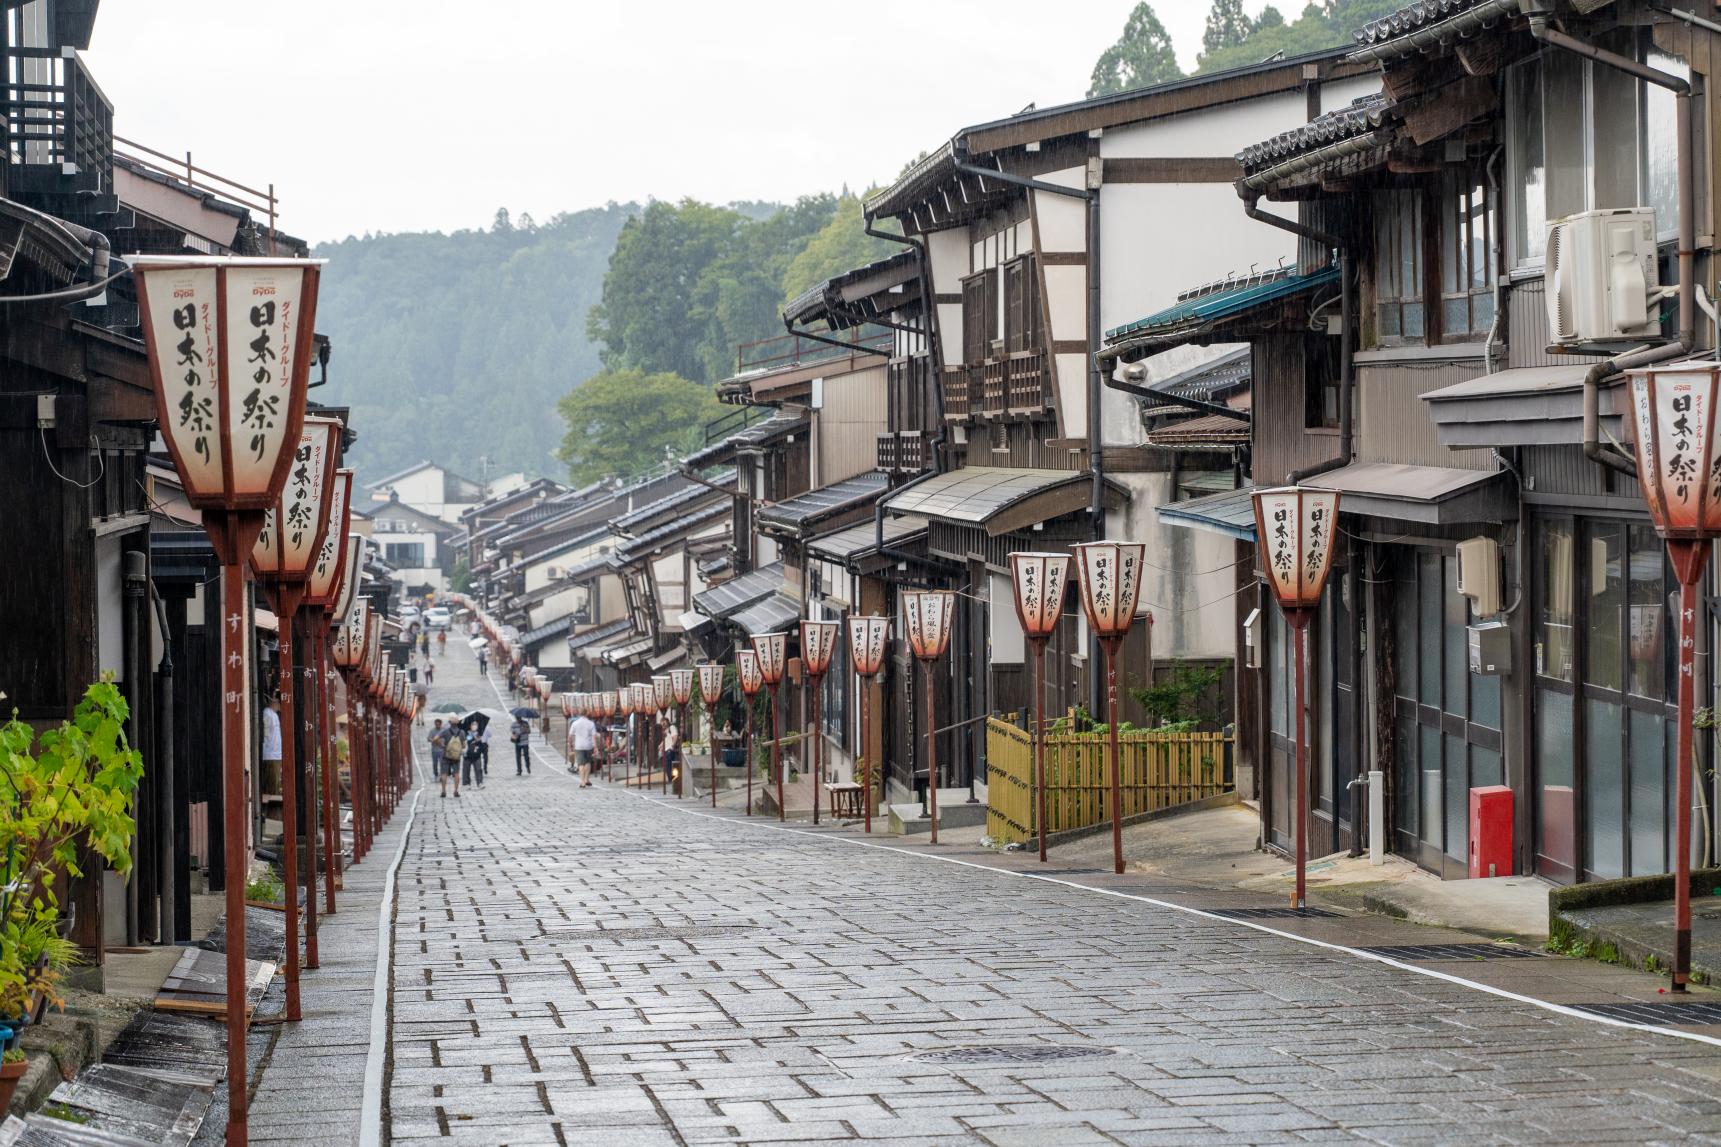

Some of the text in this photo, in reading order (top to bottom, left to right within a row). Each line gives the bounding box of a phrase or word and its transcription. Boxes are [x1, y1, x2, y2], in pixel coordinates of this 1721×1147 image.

[252, 287, 276, 297] DyDo
[201, 303, 217, 390] ダイドーグループ
[241, 301, 280, 464] 日本の祭り
[280, 301, 292, 387] ダイドーグループ
[173, 302, 213, 465] 日本の祭り
[1668, 394, 1697, 505] 日本の祭り
[287, 445, 312, 551] 日本の祭り
[1275, 509, 1292, 586] 日本の祭り
[1307, 508, 1323, 585] 日本の祭り
[1025, 566, 1037, 620] 日本の祭り
[1046, 567, 1058, 620] 日本の祭り
[1096, 558, 1111, 618] 日本の祭り
[1120, 558, 1132, 617] 日本の祭り
[226, 613, 243, 713] すわ町
[280, 641, 291, 704] すわ町
